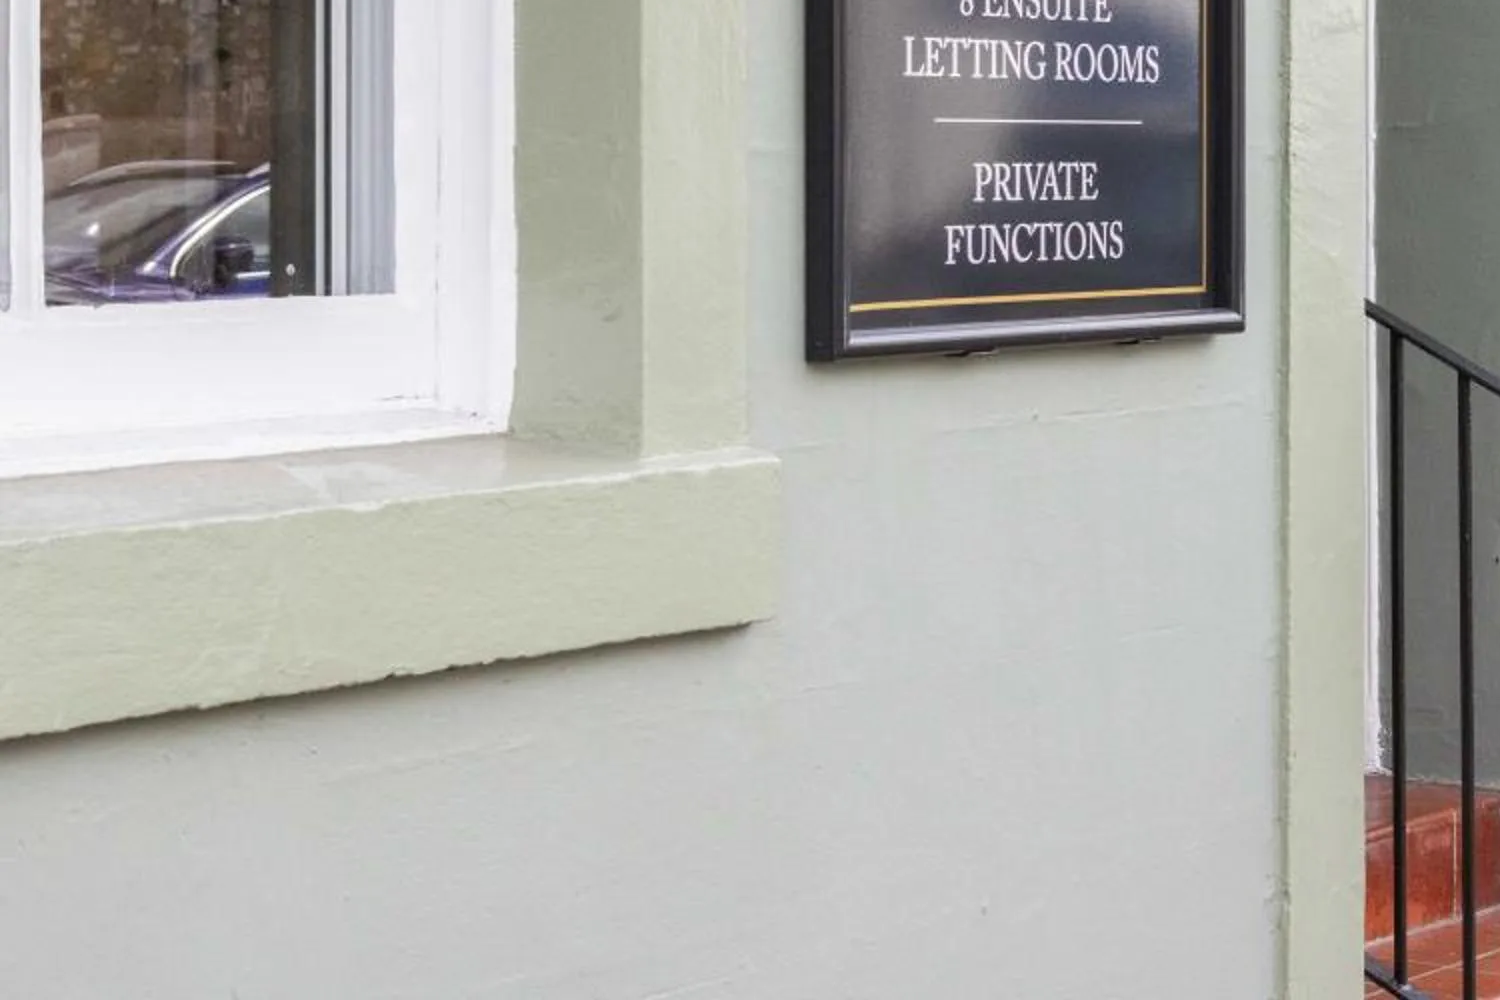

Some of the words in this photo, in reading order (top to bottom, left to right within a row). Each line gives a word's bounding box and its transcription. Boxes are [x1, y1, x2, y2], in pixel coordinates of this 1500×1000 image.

[903, 36, 1047, 81] LETTING
[1054, 43, 1160, 84] ROOMS
[972, 161, 1100, 202] PRIVATE
[944, 220, 1125, 266] FUNCTIONS
